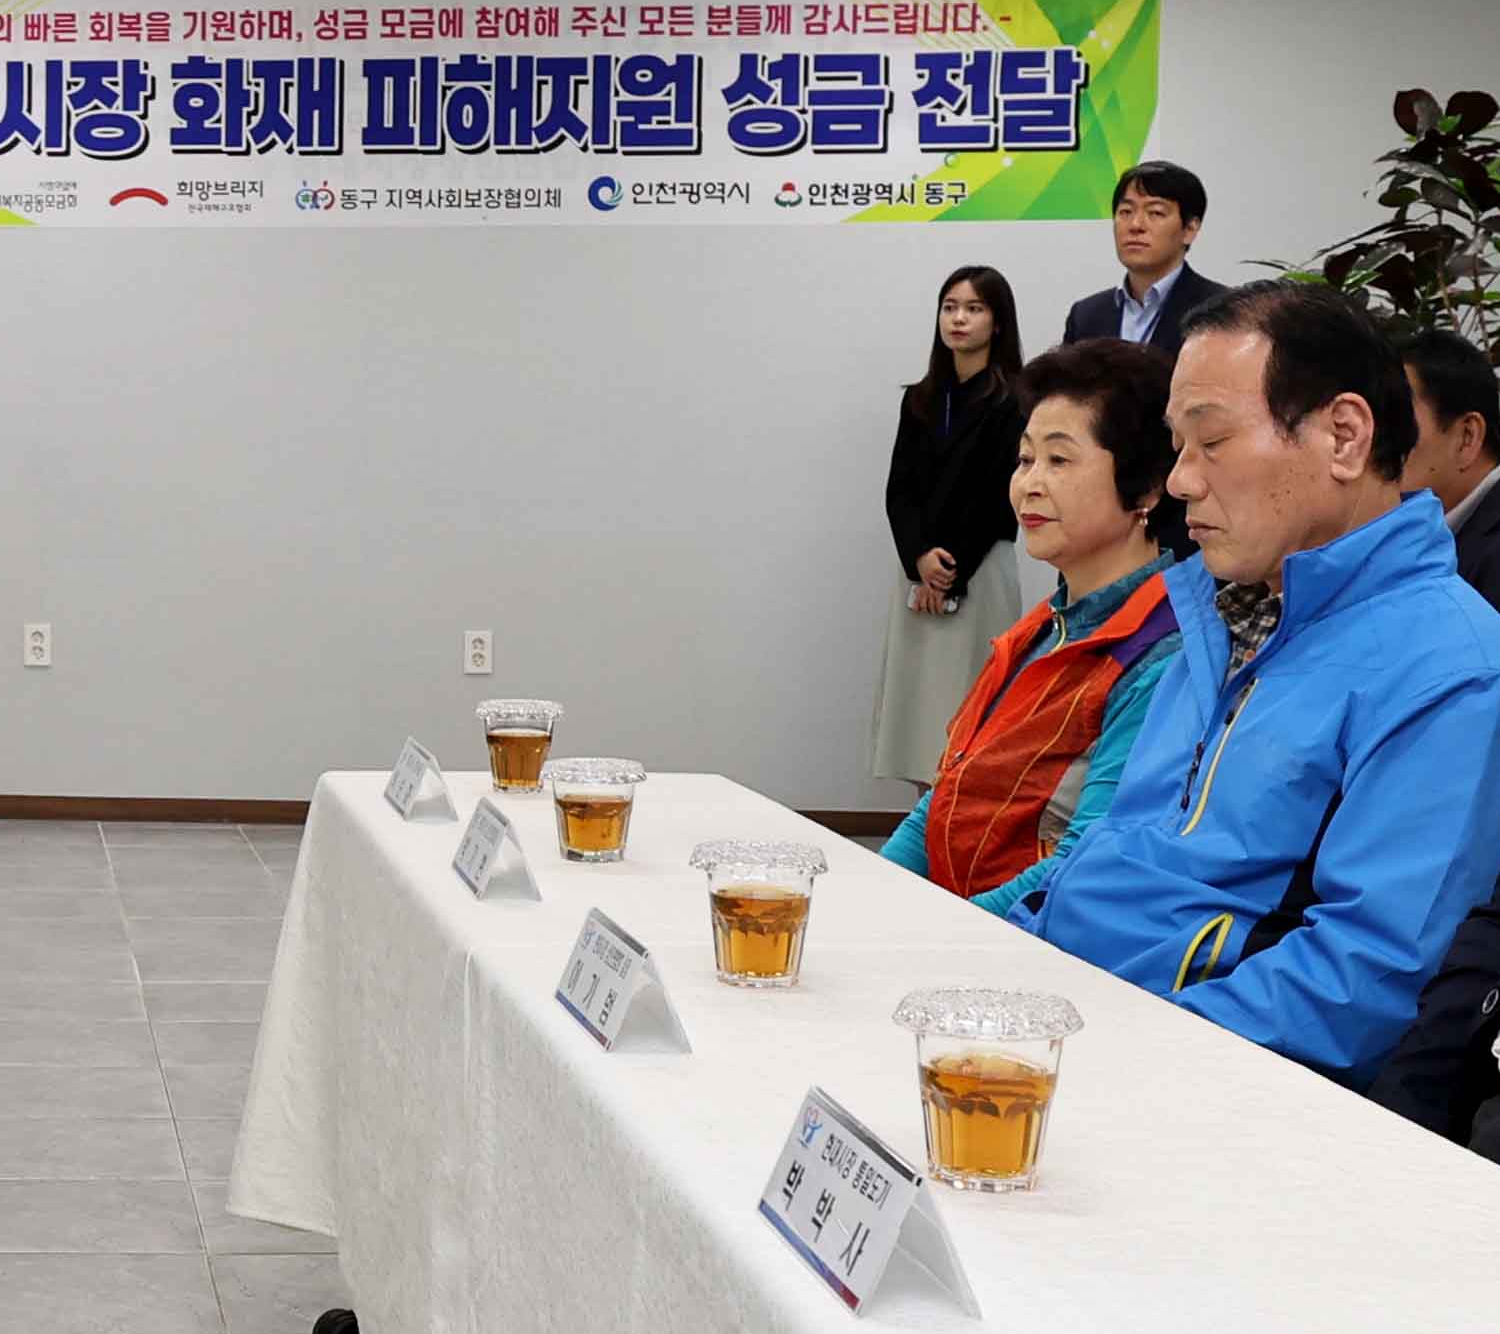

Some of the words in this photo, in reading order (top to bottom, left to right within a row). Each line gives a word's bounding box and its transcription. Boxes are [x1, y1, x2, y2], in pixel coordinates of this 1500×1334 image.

[24, 12, 77, 43] 빠른
[88, 11, 170, 42] 회복을
[183, 9, 302, 42] 기원하며,
[314, 9, 369, 41] 성금
[380, 7, 464, 40] 모금에
[475, 6, 560, 39] 참여해
[572, 6, 626, 38] 주신
[638, 5, 694, 37] 모든
[706, 4, 792, 36] 분들께
[804, 2, 989, 36] 감사드립니다.
[169, 54, 342, 155] 화재
[360, 52, 701, 155] 피해지원
[721, 51, 890, 153] 성금
[911, 47, 1086, 151] 전달
[175, 180, 265, 202] 희망브리지
[340, 188, 378, 210] 동구
[384, 187, 563, 210] 지역사회보장협의체
[631, 181, 751, 205] 인천광역시
[807, 180, 917, 206] 인천광역시
[924, 181, 969, 205] 동구
